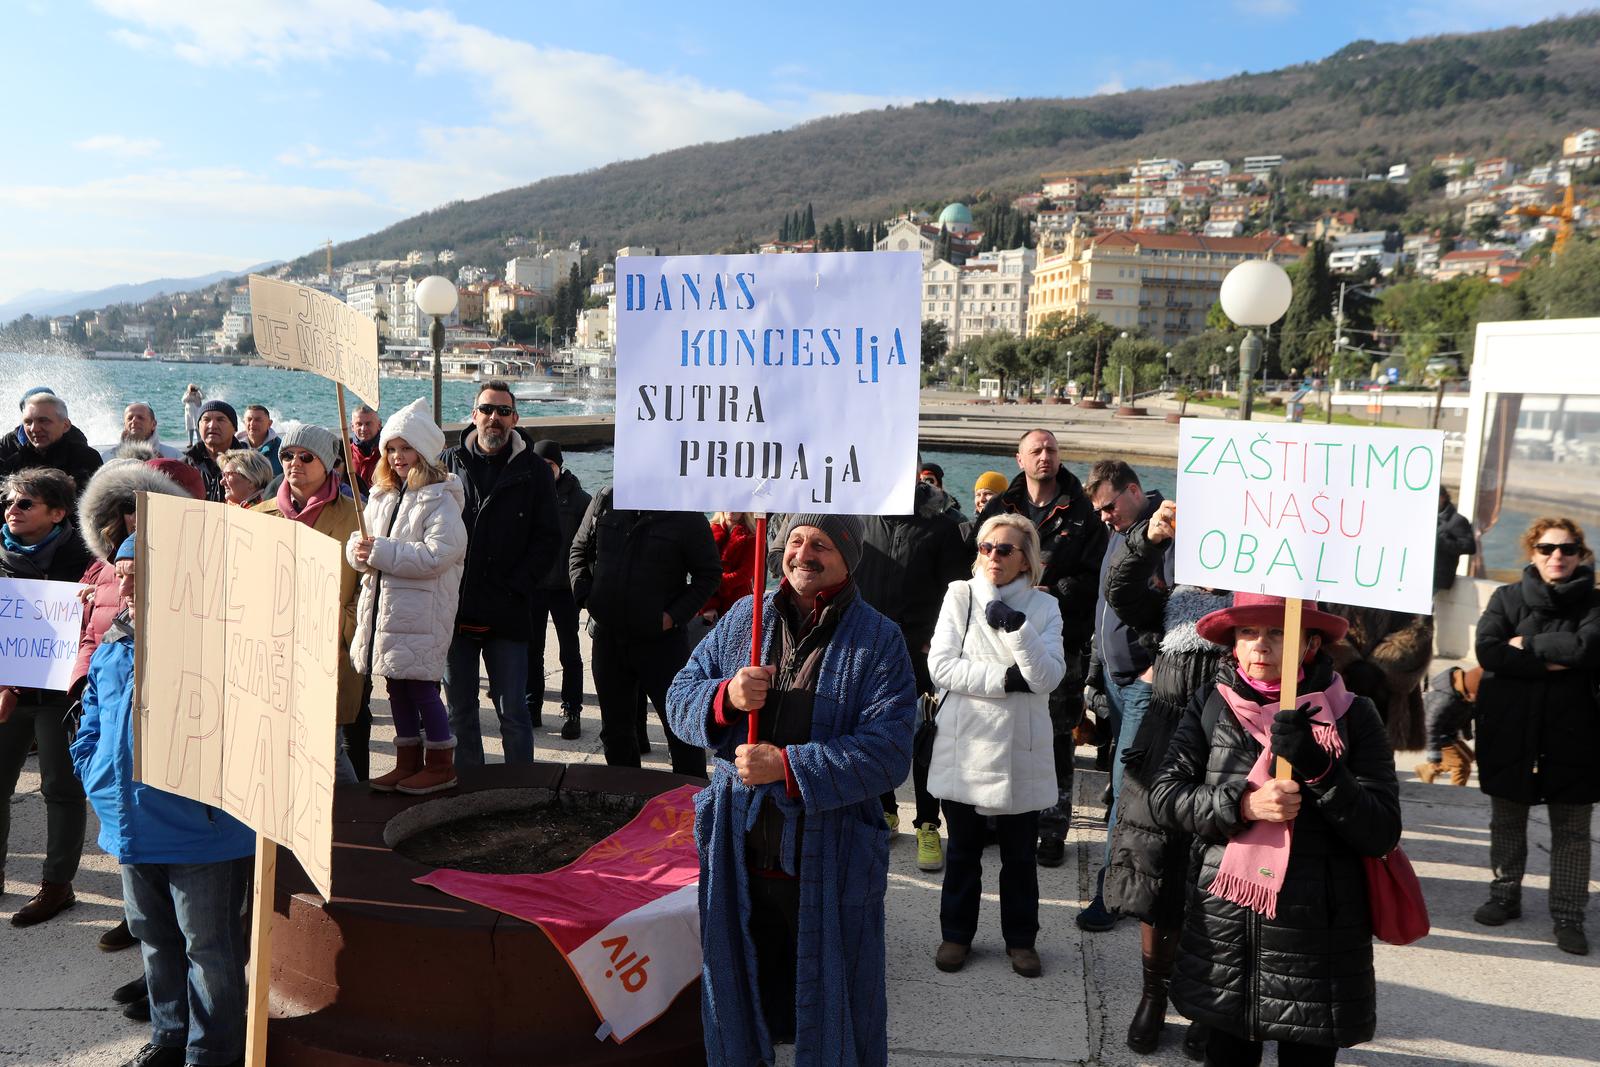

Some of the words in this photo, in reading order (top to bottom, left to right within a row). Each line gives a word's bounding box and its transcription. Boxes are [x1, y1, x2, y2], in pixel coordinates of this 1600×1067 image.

[298, 289, 358, 346] JAVNO
[626, 272, 756, 312] DANAS
[258, 315, 290, 361] JE
[296, 323, 345, 381] NAŠE
[637, 384, 766, 423] SUTRA
[1183, 431, 1434, 491] ZAŠTITIMO
[1243, 489, 1366, 538] NAŠU
[1198, 529, 1409, 592] OBALU!
[33, 599, 81, 624] SVIMA
[169, 508, 254, 624] NE
[271, 540, 340, 678] DAMO
[30, 637, 78, 660] NEKIMA
[165, 671, 334, 893] PLAŽE
